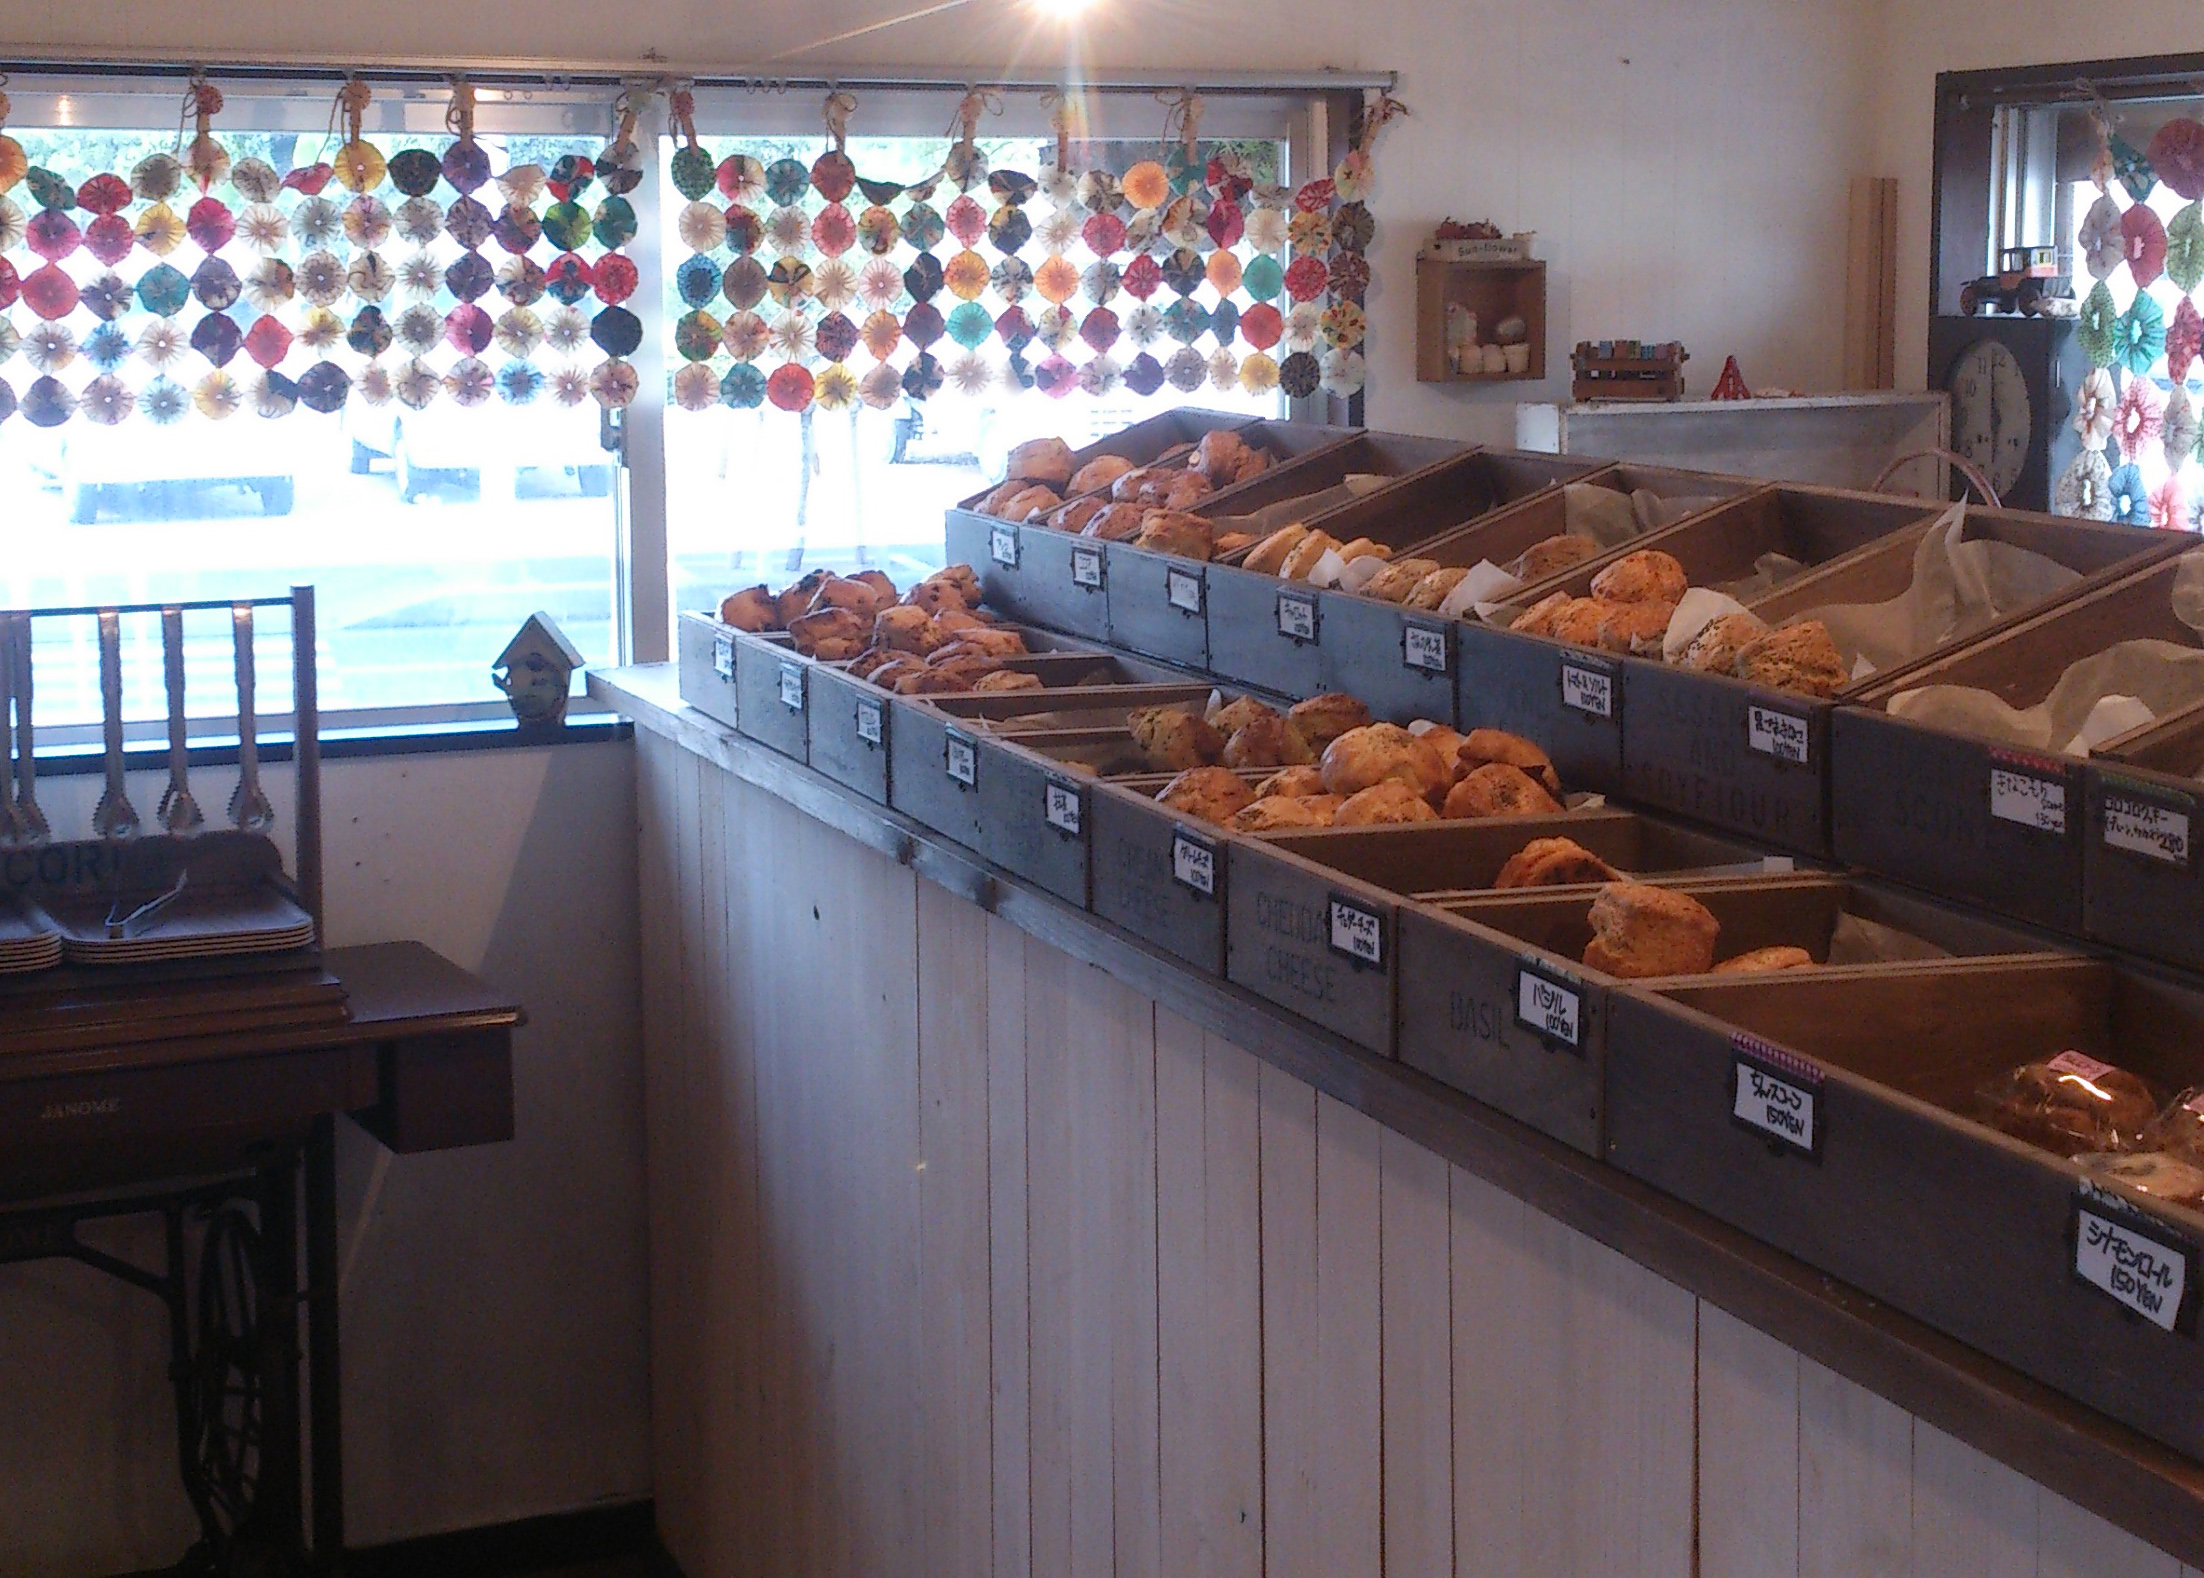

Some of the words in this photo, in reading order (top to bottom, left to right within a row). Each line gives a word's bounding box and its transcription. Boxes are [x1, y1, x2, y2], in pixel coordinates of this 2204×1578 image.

[1532, 982, 1567, 1016] バジル
[2086, 1220, 2173, 1289] シナモンロール
[2109, 1264, 2164, 1315] 150YEN
